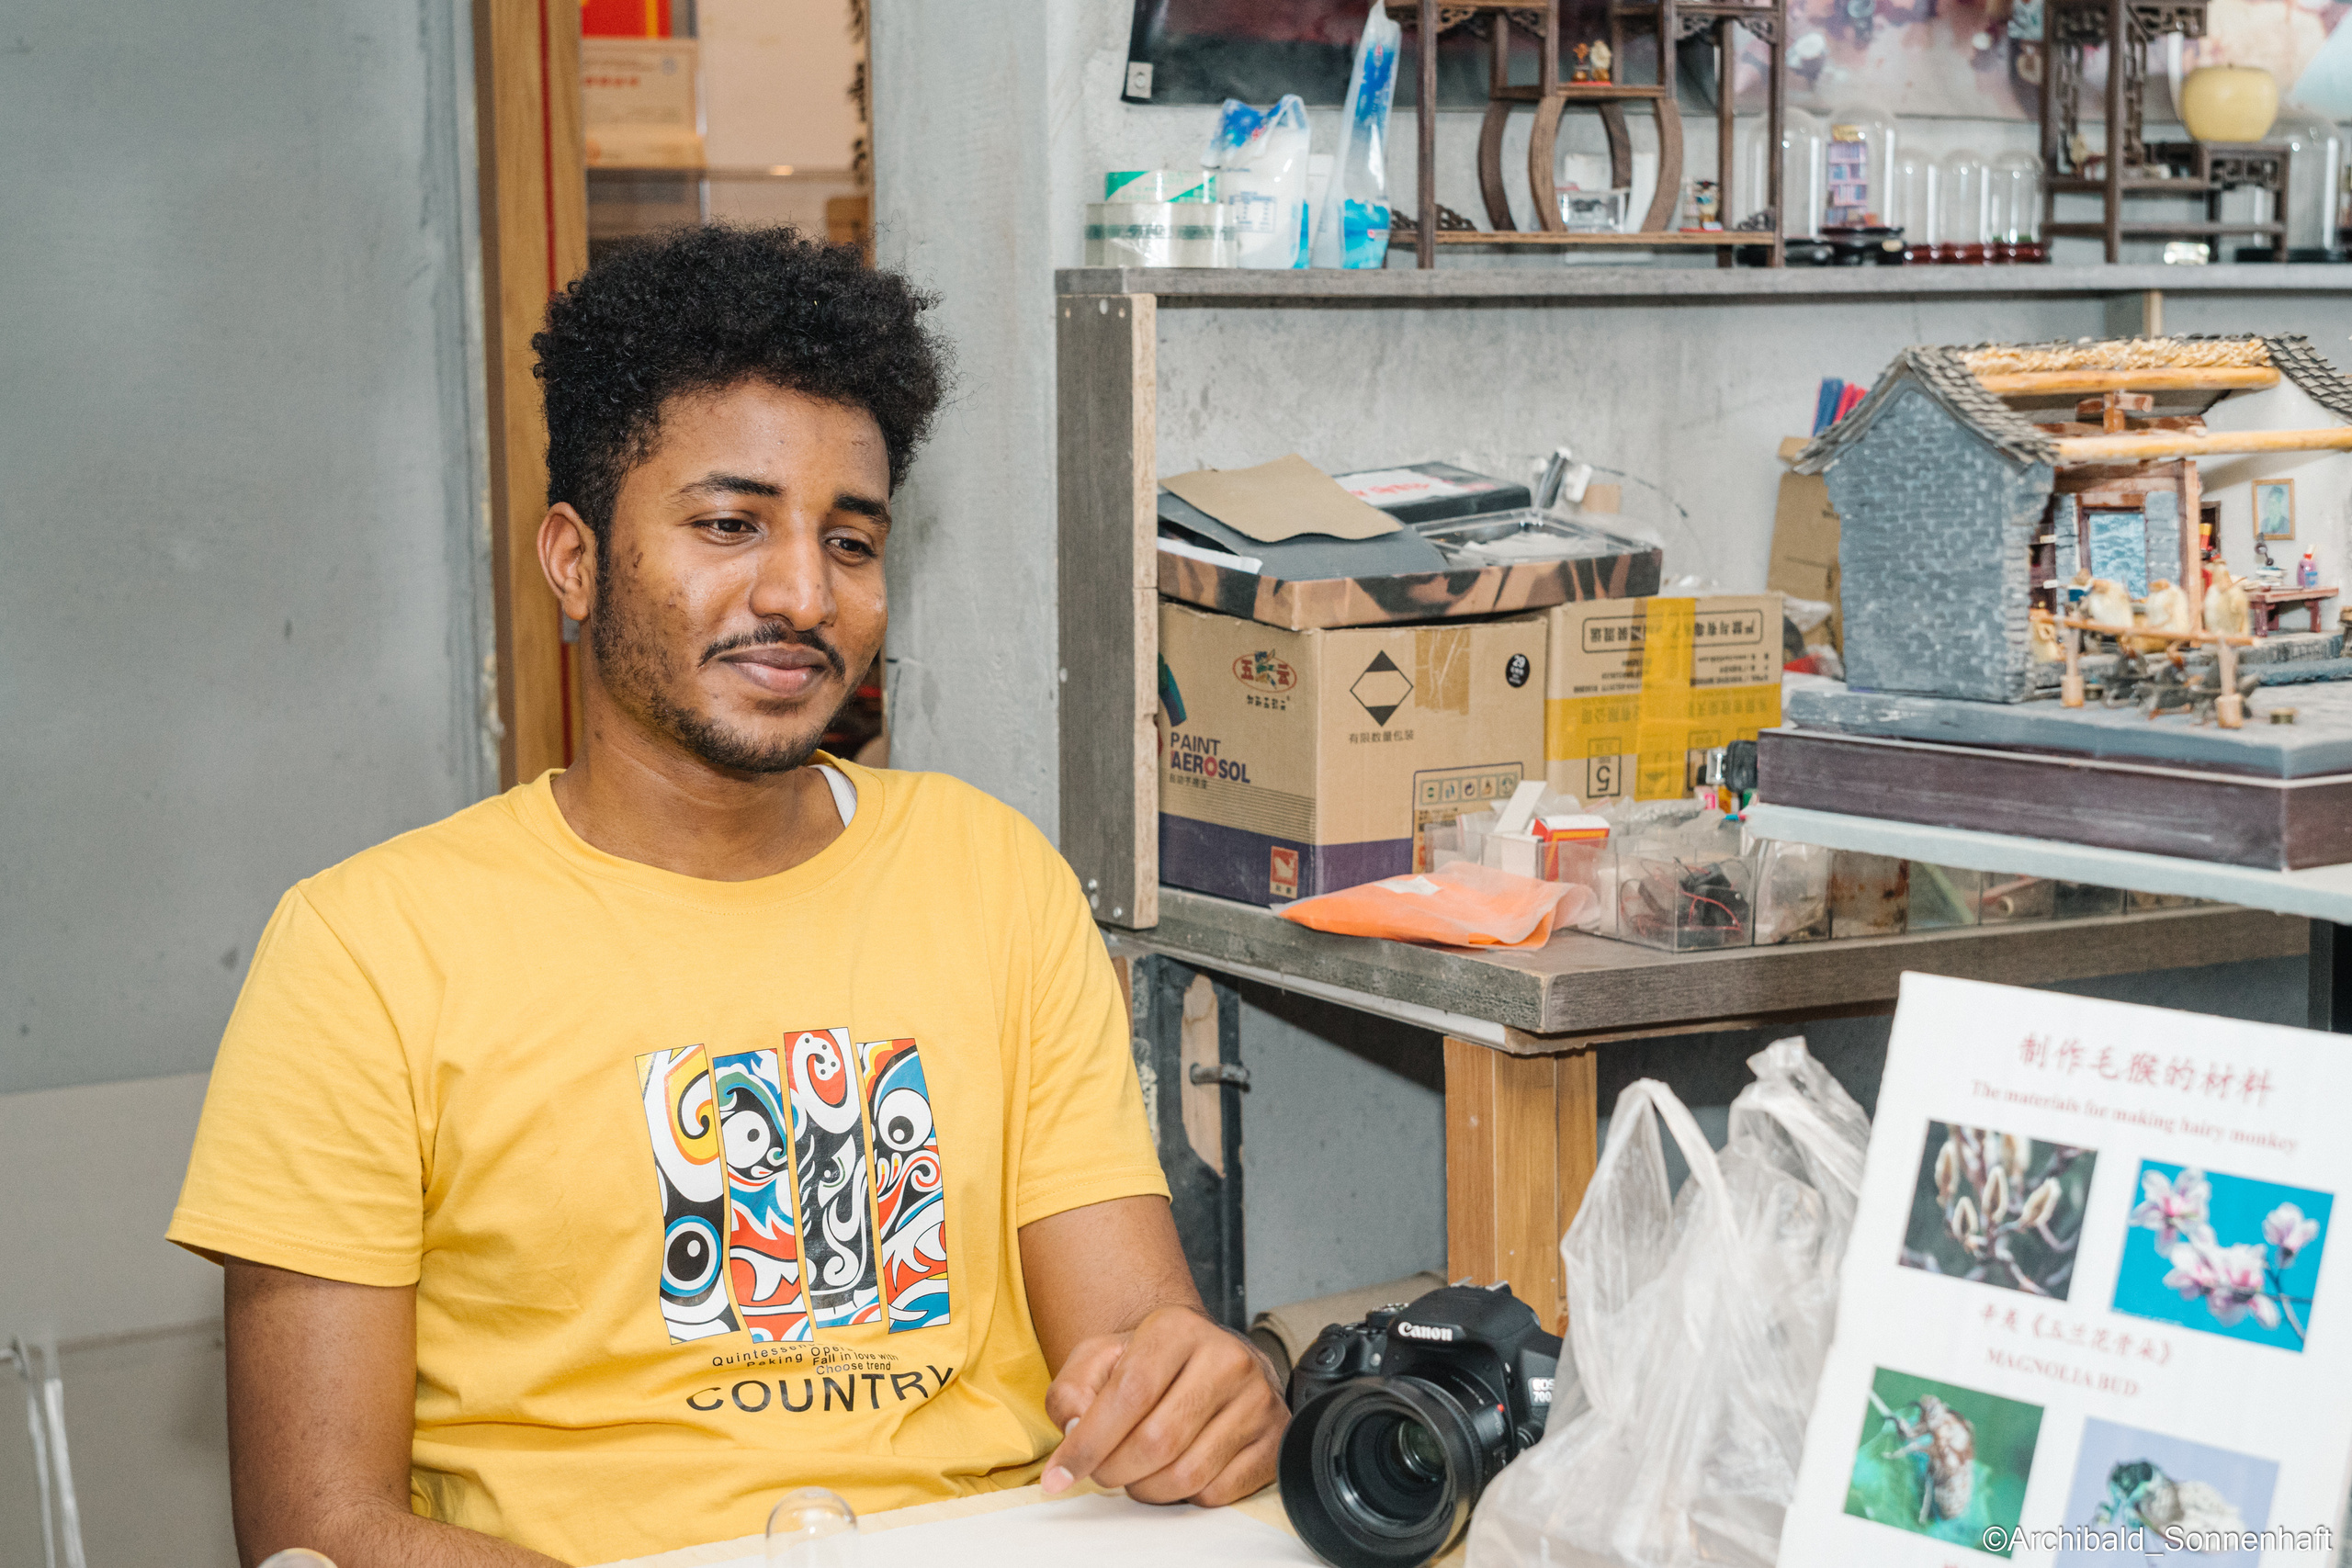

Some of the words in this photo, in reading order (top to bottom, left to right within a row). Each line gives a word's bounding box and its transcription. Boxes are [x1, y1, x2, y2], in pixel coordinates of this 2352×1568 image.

[1170, 732, 1221, 756] PAINT
[1350, 729, 1415, 744] 有限数量包装
[1170, 750, 1250, 784] AEROSOL
[1596, 765, 1611, 792] 5
[1973, 1079, 1998, 1098] The
[2007, 1090, 2079, 1112] materials
[2086, 1100, 2107, 1117] for
[2113, 1110, 2174, 1133] making
[2181, 1118, 2223, 1142] hairy
[2231, 1129, 2297, 1154] monkey
[1397, 1322, 1453, 1341] Canon
[712, 1344, 814, 1367] Quintessen
[747, 1353, 803, 1367] Peking
[813, 1354, 835, 1366] Fall
[840, 1352, 852, 1360] in
[816, 1361, 864, 1375] Choose
[866, 1361, 891, 1370] trend
[1987, 1347, 2093, 1388] MAGNOLIA
[2098, 1372, 2140, 1397] BUD
[685, 1365, 954, 1412] COUNTRY
[1532, 1378, 1555, 1392] EOS
[1532, 1391, 1553, 1404] 700
